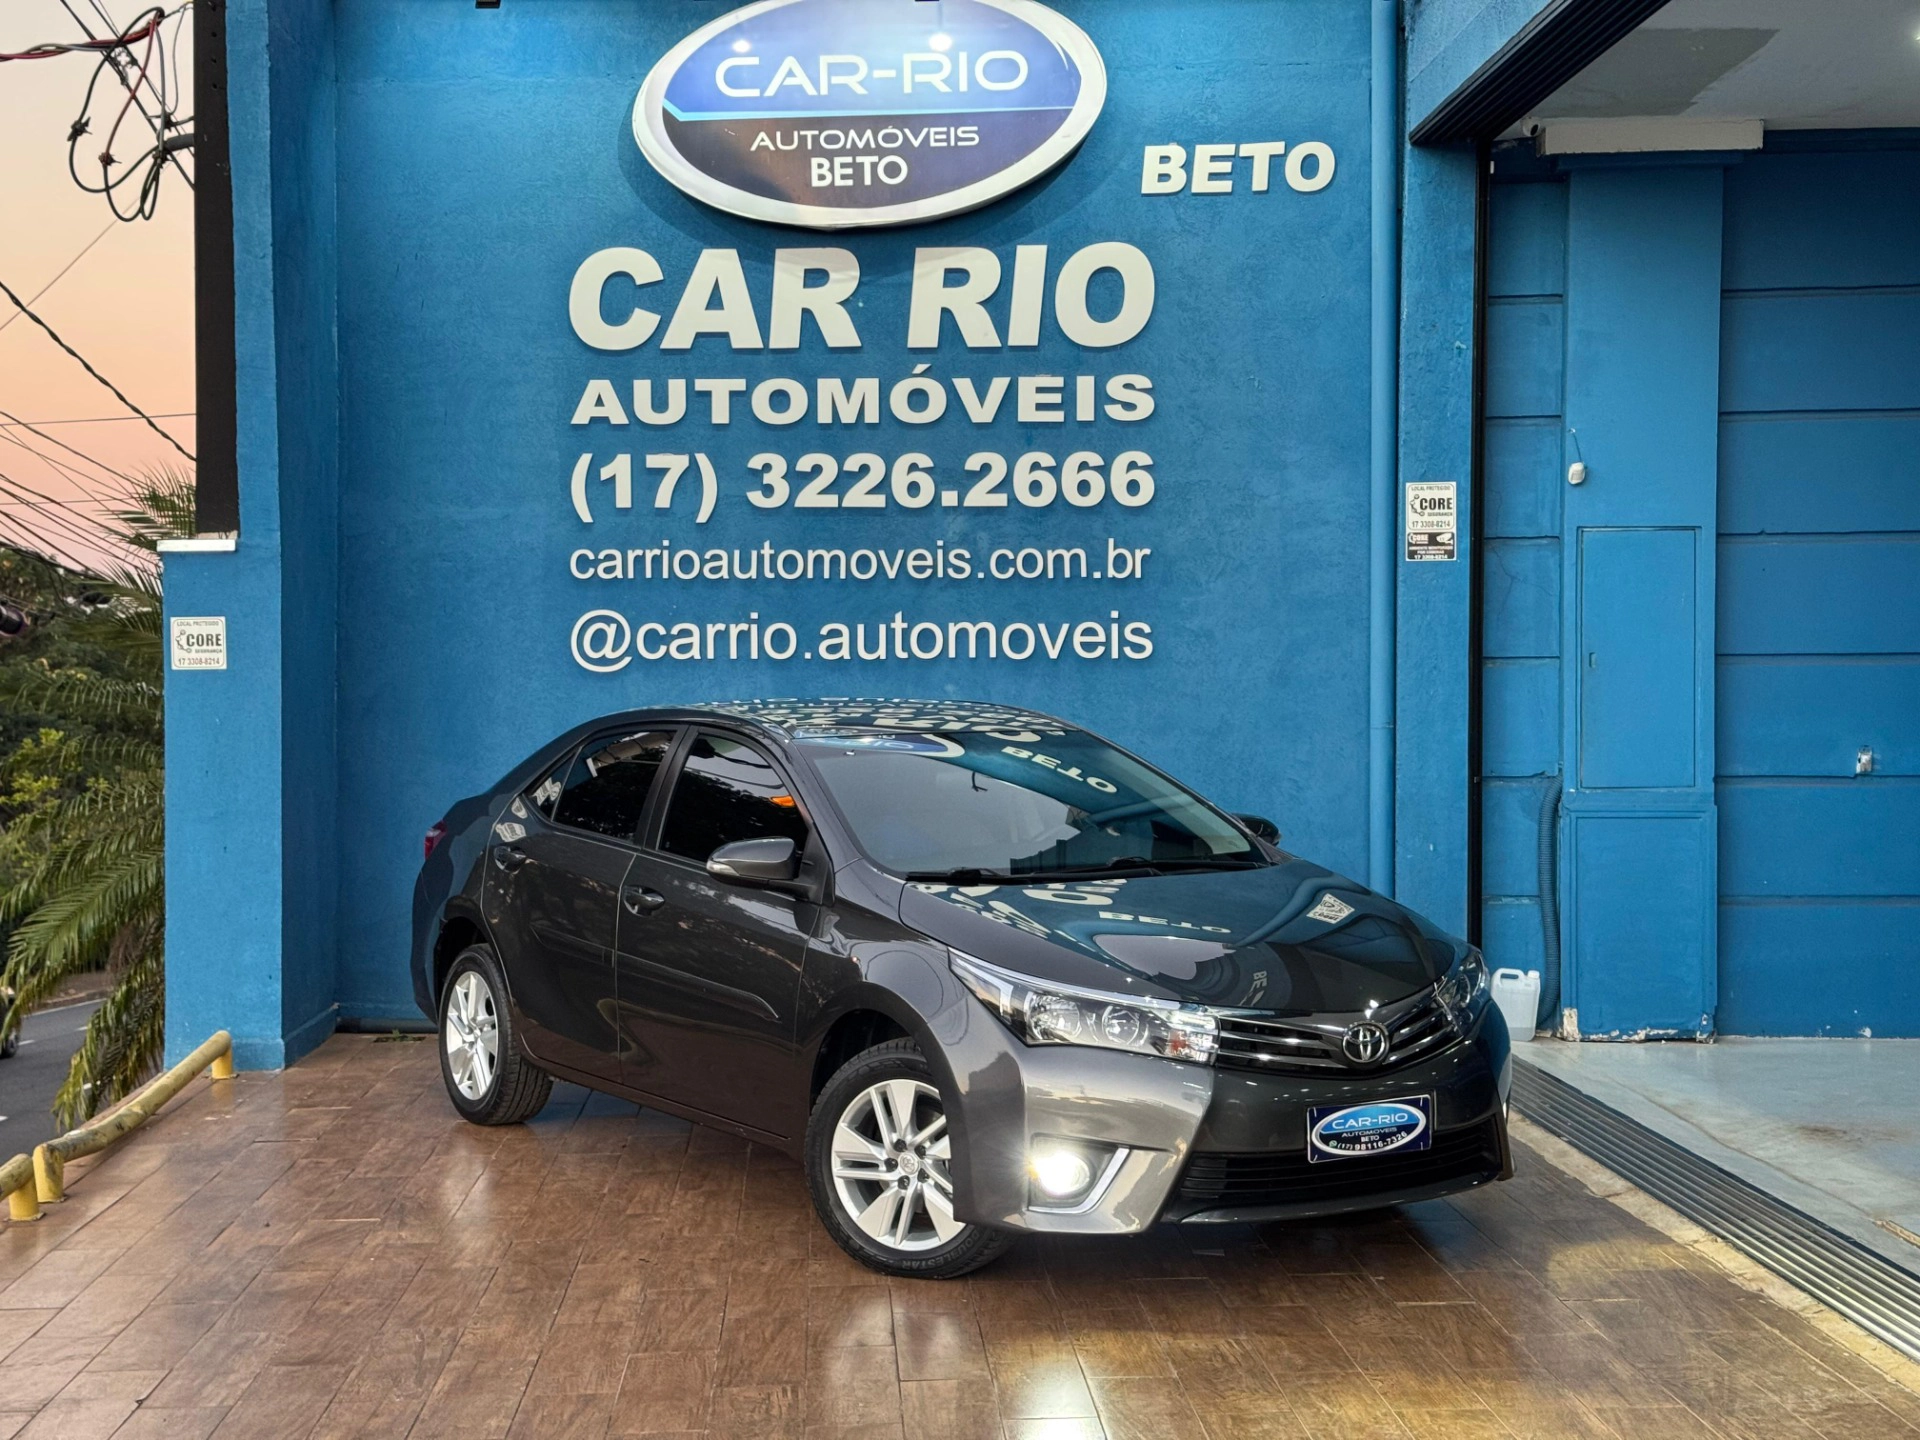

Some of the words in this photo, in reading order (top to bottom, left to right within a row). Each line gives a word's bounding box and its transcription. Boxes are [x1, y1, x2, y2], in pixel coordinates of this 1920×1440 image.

[714, 49, 1029, 98] CAR-RIO
[749, 125, 980, 152] AUTOMÓVEIS
[810, 155, 908, 188] BETO
[1140, 140, 1336, 195] BETO
[568, 246, 862, 351] CAR
[906, 241, 1156, 348] RIO
[570, 364, 1156, 426] AUTOMÓVEIS
[570, 452, 718, 524] (17)
[745, 450, 1156, 509] 3226.2666
[1420, 498, 1453, 510] CORE
[569, 538, 1152, 581] carrioautomoveis.com.br
[186, 634, 222, 647] CORE
[570, 609, 1154, 673] @carrio.automoveis
[1332, 1112, 1408, 1129] CAR-RIO
[1337, 1142, 1353, 1151] (17)
